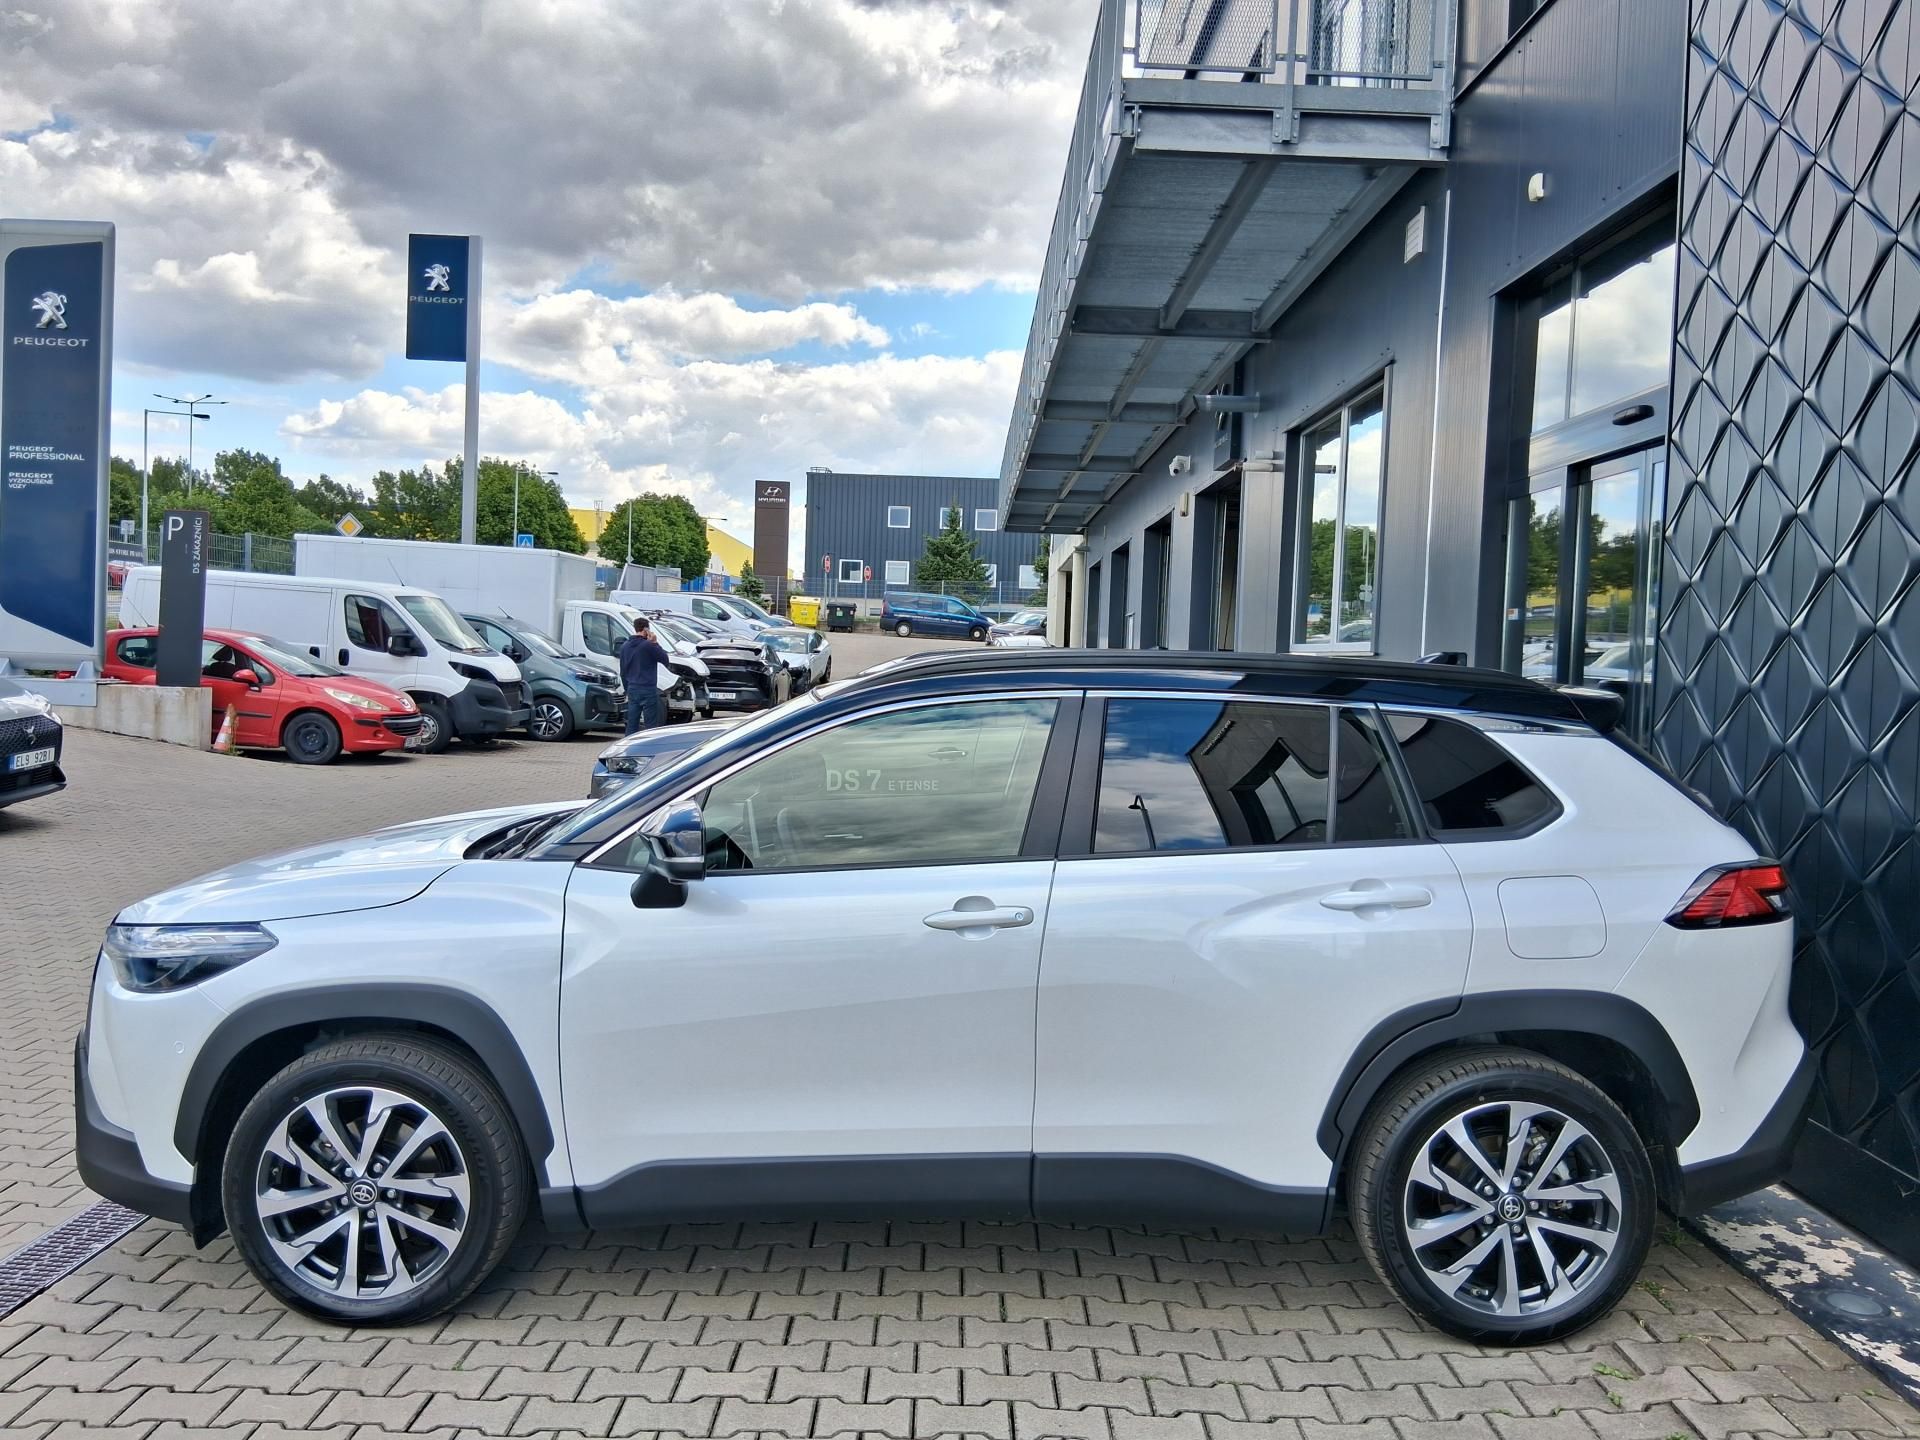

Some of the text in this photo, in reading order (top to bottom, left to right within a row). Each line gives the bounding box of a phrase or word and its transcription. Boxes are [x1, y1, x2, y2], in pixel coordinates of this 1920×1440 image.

[409, 295, 465, 304] PEUGEOT
[13, 336, 89, 347] PEUGEOT
[9, 451, 85, 461] PROFESSIONAL
[8, 471, 54, 479] PEUGEOT
[167, 516, 184, 541] P
[191, 517, 203, 574] DS ZÁKAZNÍCI
[16, 754, 30, 767] EL9
[826, 769, 860, 792] DS
[866, 769, 881, 791] 7
[898, 779, 939, 791] TENSE
